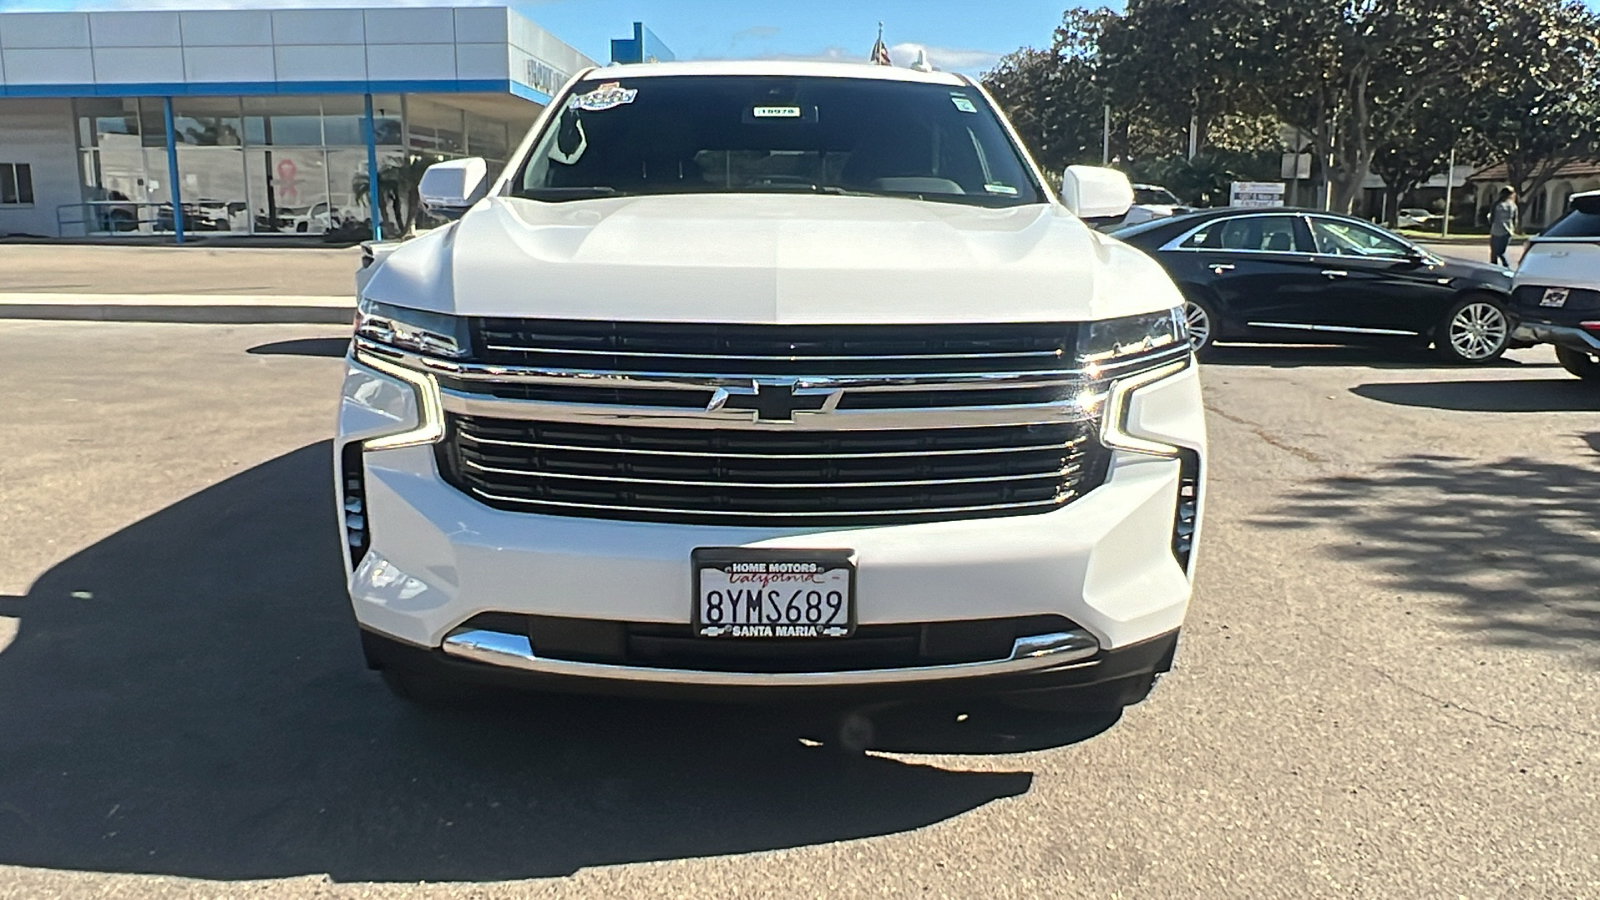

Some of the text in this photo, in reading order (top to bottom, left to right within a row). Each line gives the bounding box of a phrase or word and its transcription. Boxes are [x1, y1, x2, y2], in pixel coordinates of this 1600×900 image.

[732, 563, 817, 573] HOME MOTORS
[706, 589, 842, 624] 8YMS689
[732, 625, 818, 637] SANTA MARIA
